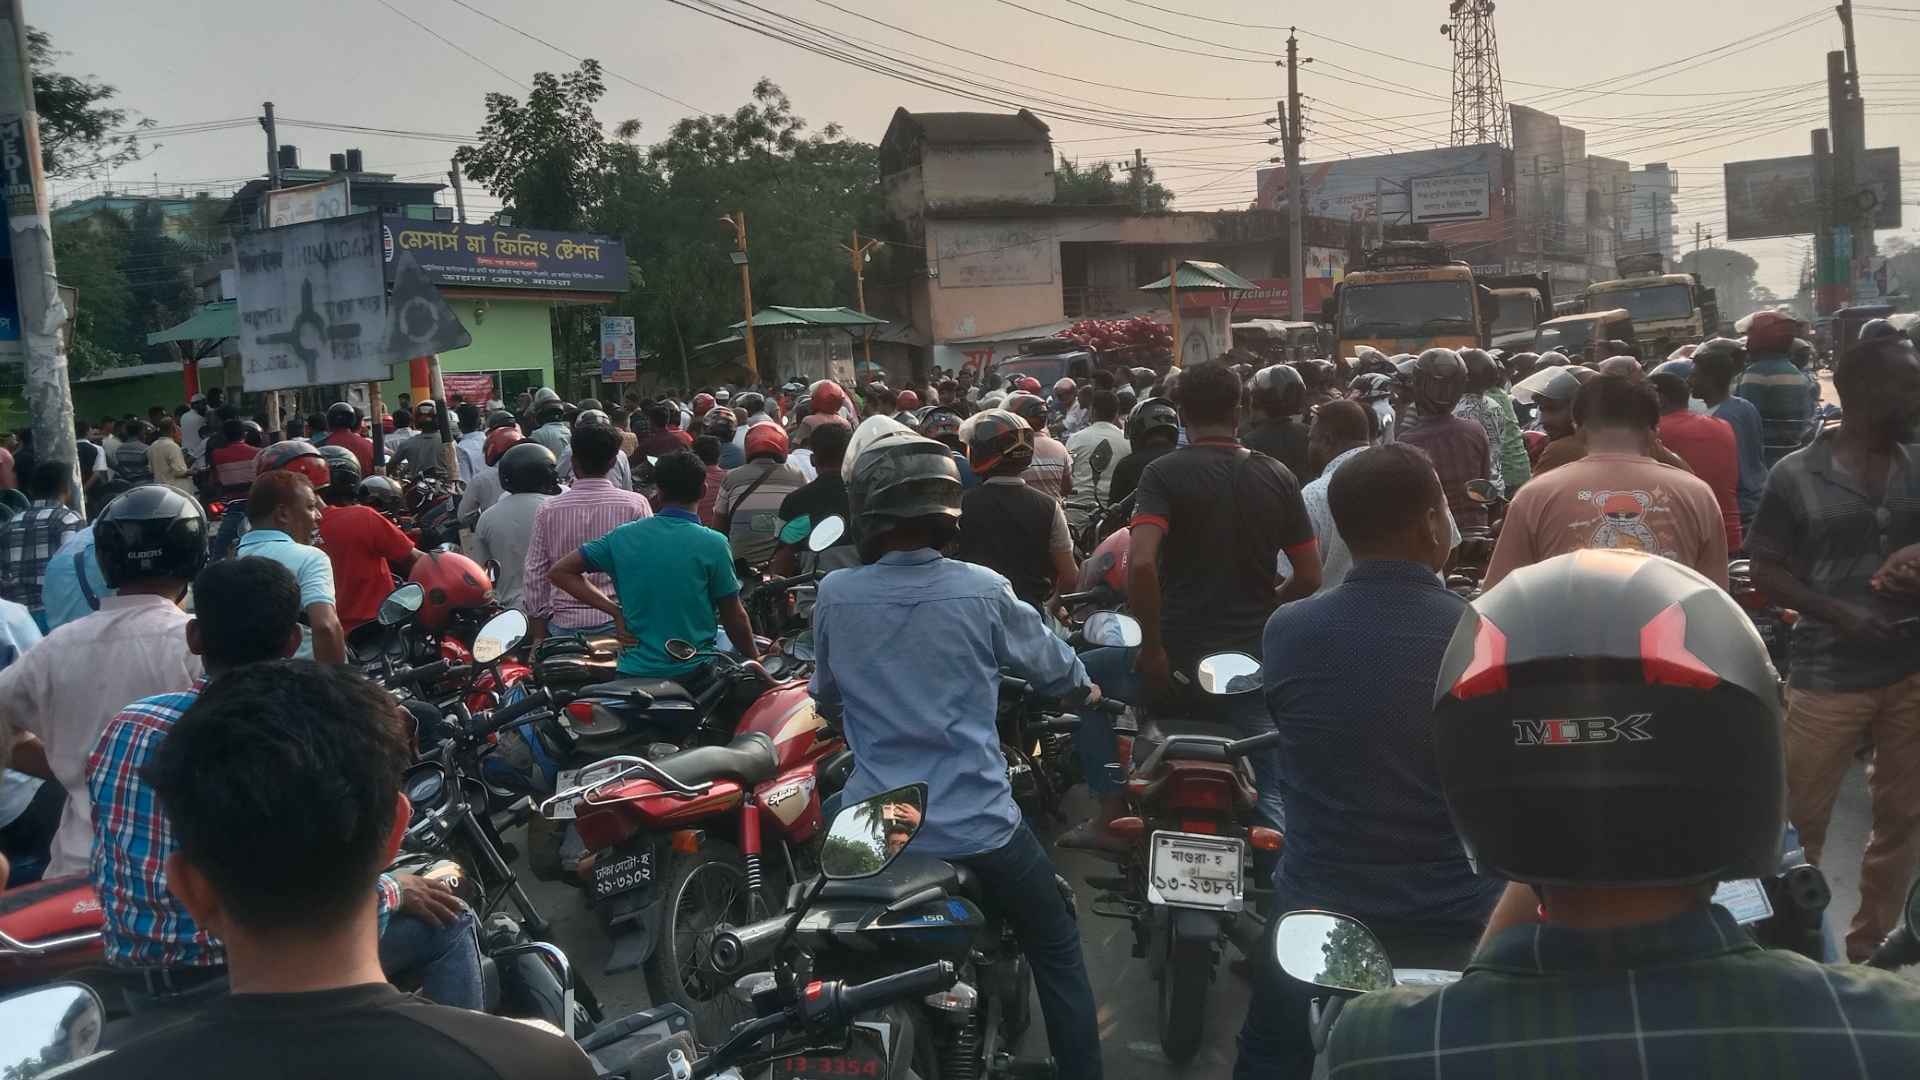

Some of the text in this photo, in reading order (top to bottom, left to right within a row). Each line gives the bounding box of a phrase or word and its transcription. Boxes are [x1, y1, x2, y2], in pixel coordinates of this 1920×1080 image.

[399, 226, 459, 252] মেসার্স
[465, 236, 486, 254] মা
[493, 232, 550, 259] ফিলিং
[555, 239, 600, 262] ষ্টেশন
[1155, 875, 1235, 896] ১৩-২৩৮৭
[922, 914, 945, 922] 150
